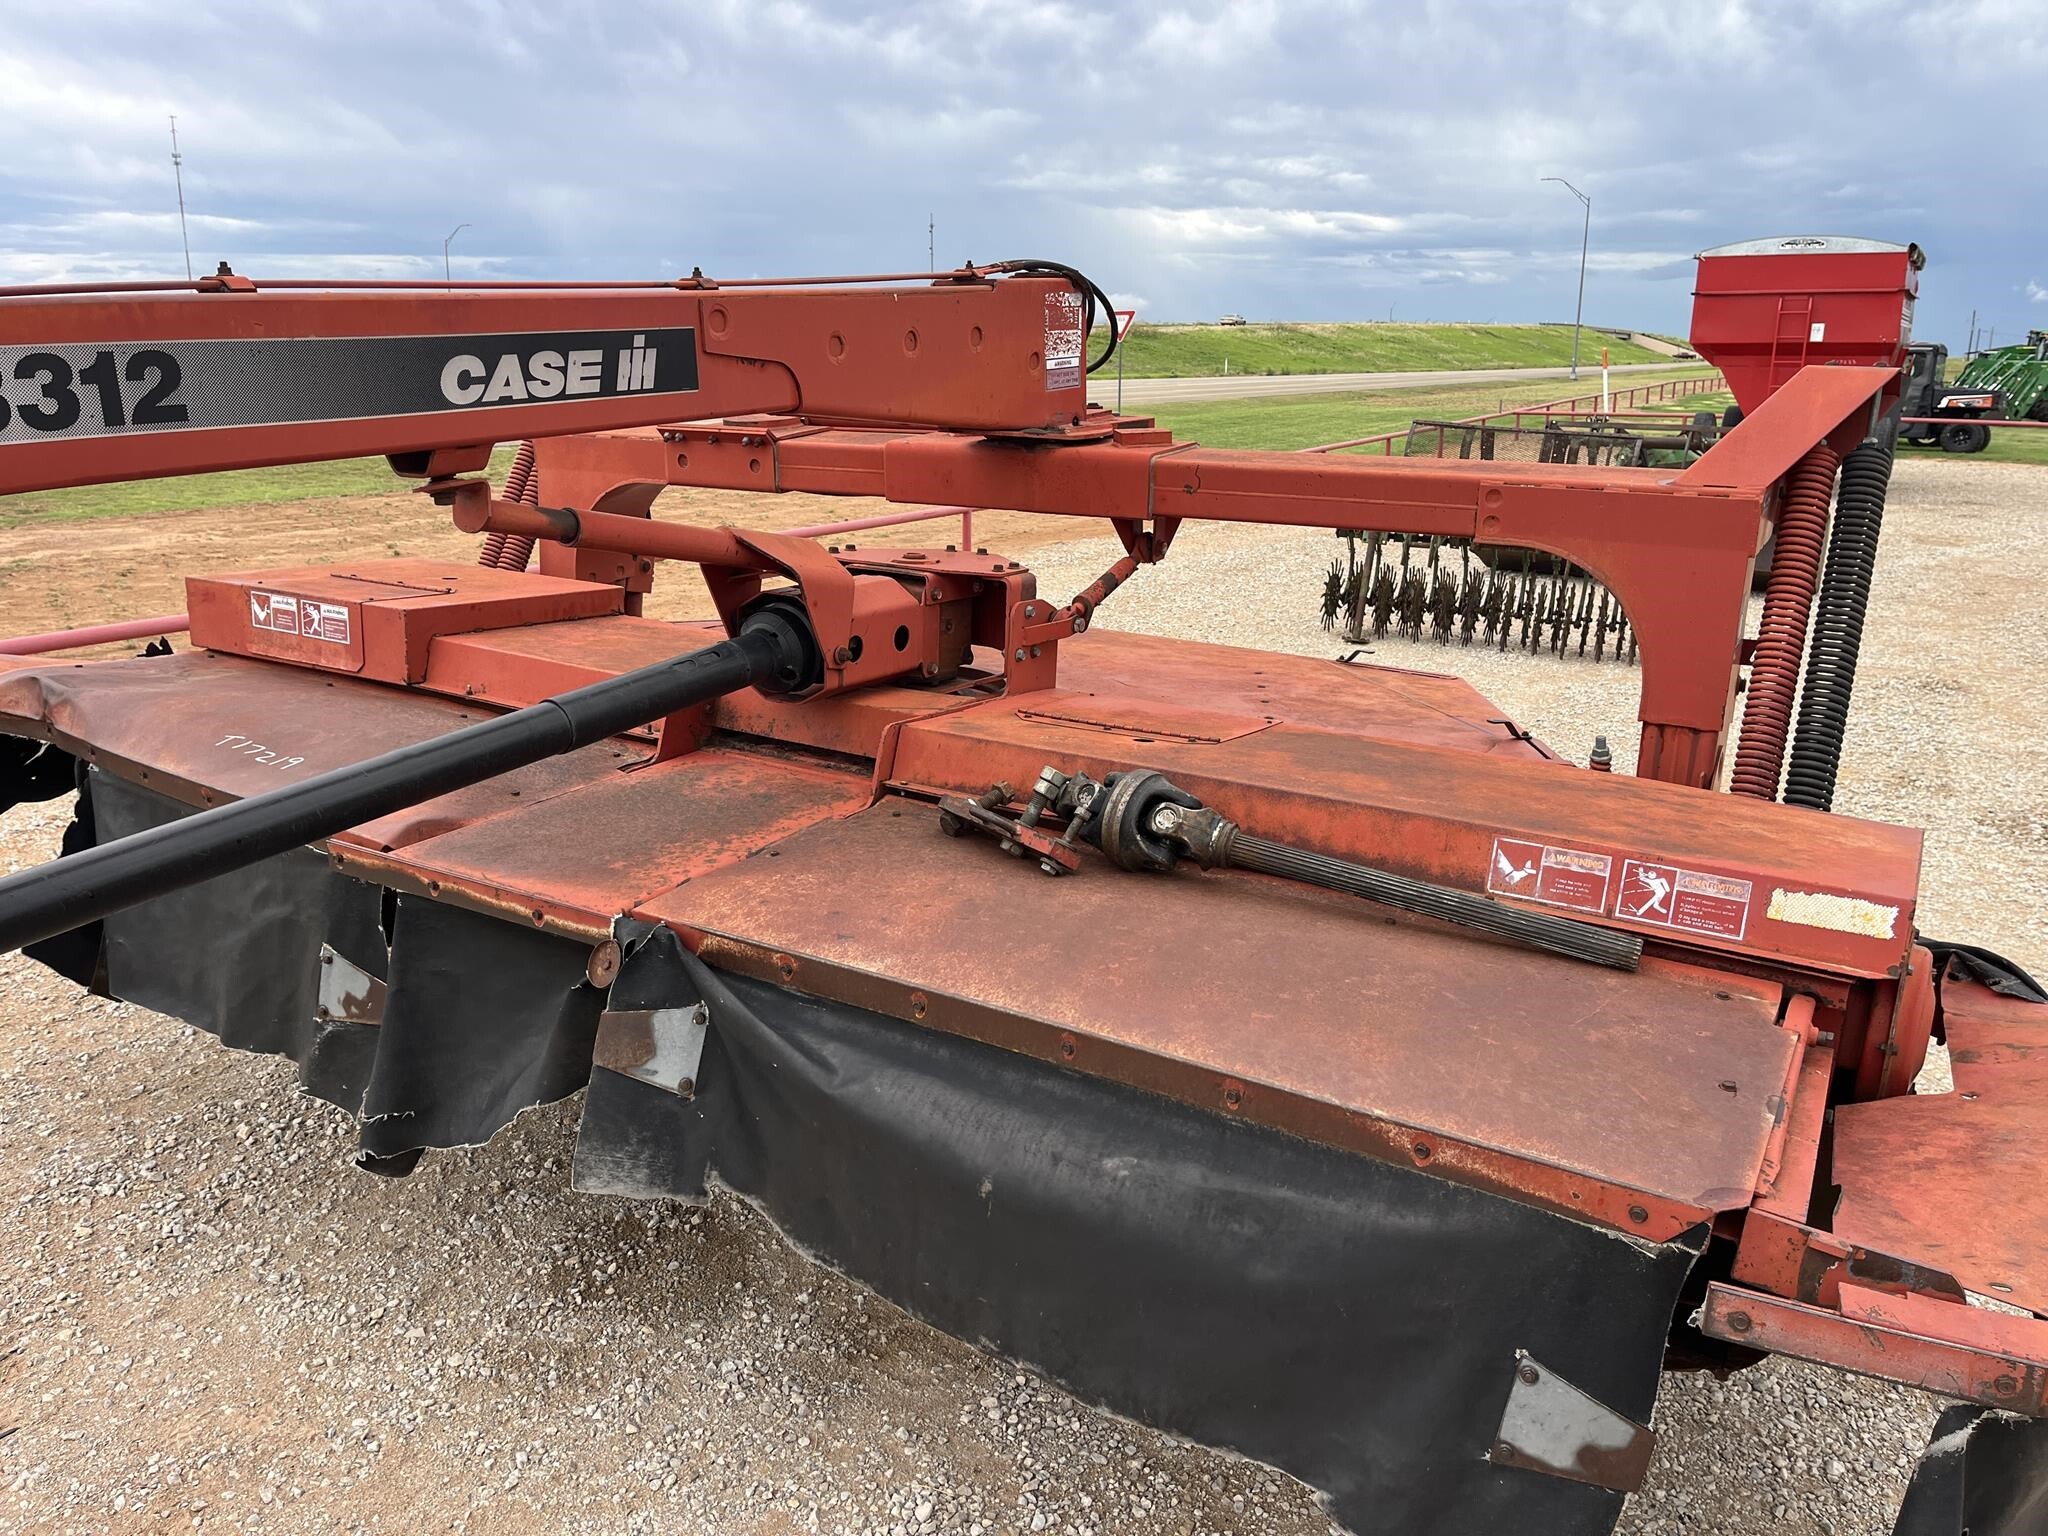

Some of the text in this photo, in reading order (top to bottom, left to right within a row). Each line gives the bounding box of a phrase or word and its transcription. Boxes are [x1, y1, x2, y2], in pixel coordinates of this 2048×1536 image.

[0, 349, 190, 433] 312
[440, 350, 603, 405] CASE
[215, 735, 305, 770] T17219
